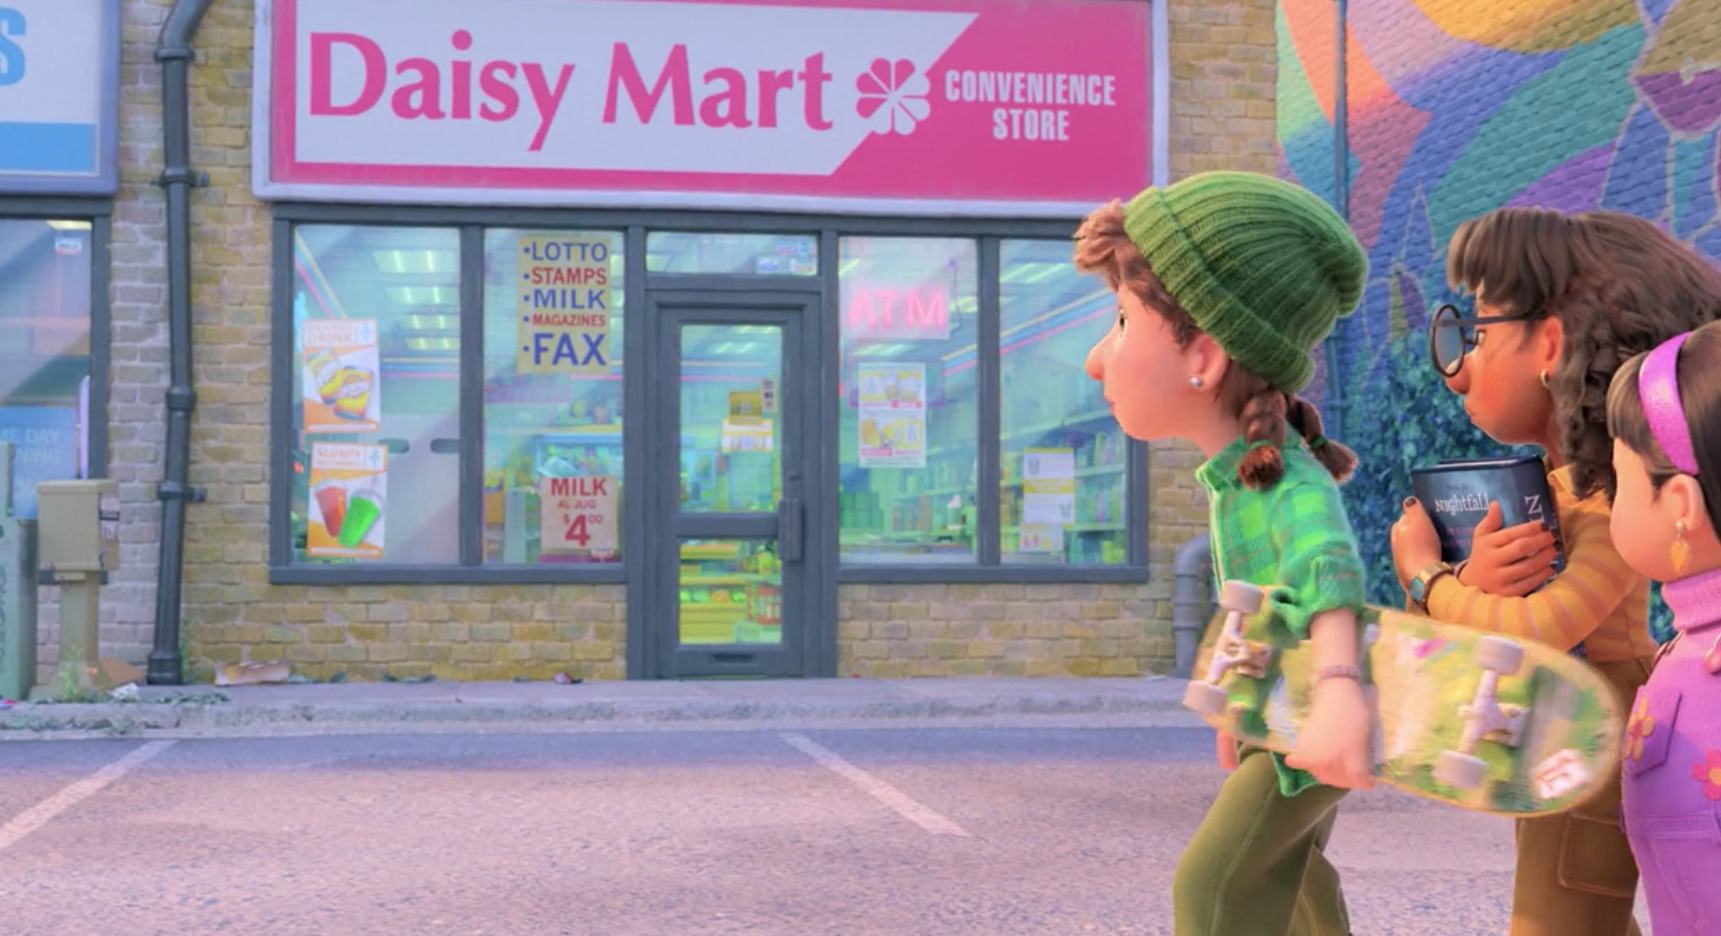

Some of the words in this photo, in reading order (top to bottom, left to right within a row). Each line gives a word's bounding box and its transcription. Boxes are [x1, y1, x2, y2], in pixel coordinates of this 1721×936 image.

[309, 29, 576, 152] Daisy
[602, 42, 834, 131] Mart
[944, 69, 1117, 106] CONVENIENCE
[992, 107, 1070, 141] STORE
[531, 241, 608, 262] LOTTO
[531, 266, 607, 285] STAMPS
[533, 288, 606, 310] MILK
[846, 288, 946, 329] ATM
[531, 314, 606, 327] MAGAZINES
[533, 332, 607, 366] FAX
[26, 428, 60, 444] DAY
[551, 478, 607, 497] MILK
[557, 500, 570, 510] 4L
[574, 500, 597, 510] JUG
